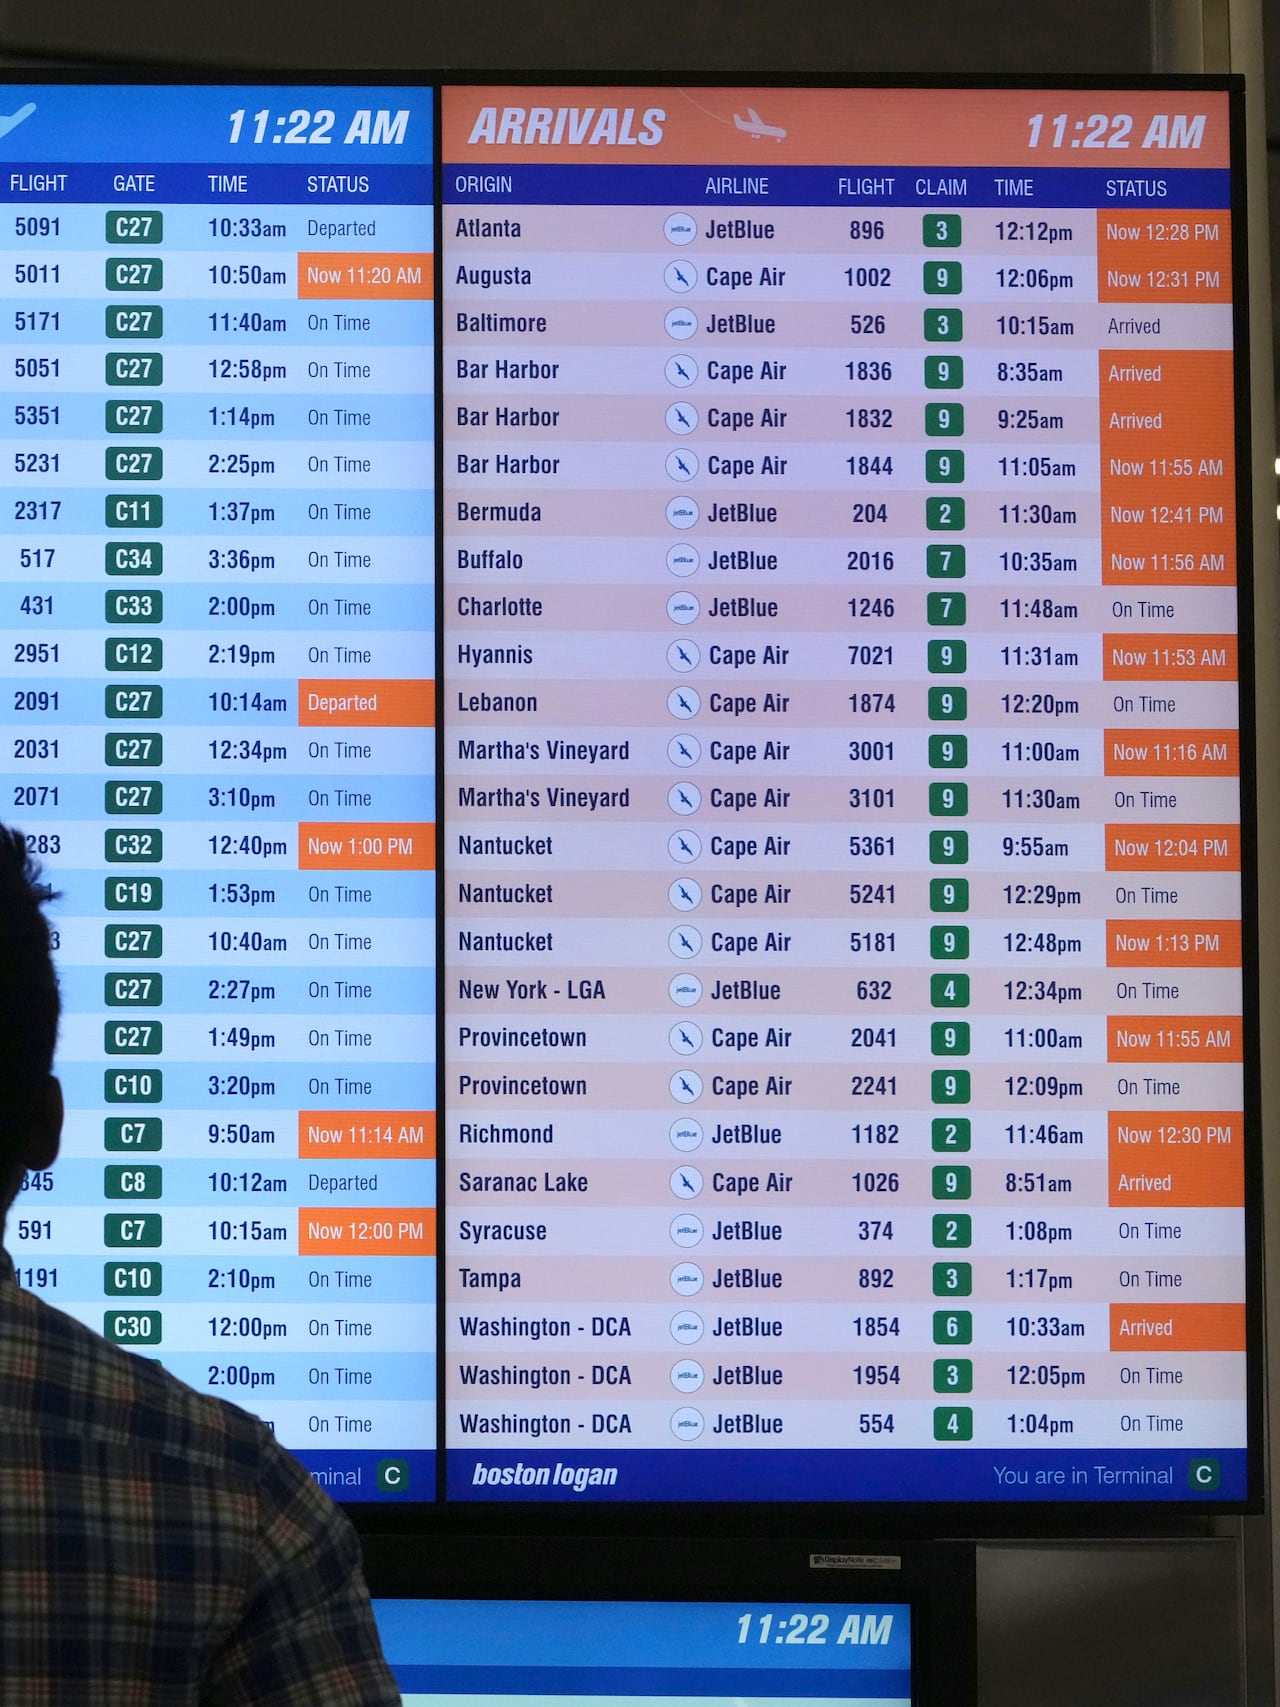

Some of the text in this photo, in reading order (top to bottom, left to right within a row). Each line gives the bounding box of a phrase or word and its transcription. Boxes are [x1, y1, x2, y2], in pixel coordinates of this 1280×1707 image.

[229, 109, 411, 145] 11:22 AM
[467, 107, 666, 146] ARRIVALS
[1026, 113, 1208, 149] 11:22 AM
[10, 174, 68, 192] FLIGHT
[113, 173, 155, 192] GATE
[207, 174, 248, 193] TIME
[307, 175, 370, 193] STATUS
[455, 175, 1168, 197] ORIGIN AIRLINE FLIGHT CLAIM TIME STATUS
[455, 218, 521, 238] Atlanta
[705, 219, 775, 239] JetBlue
[849, 220, 885, 240] 896
[936, 220, 948, 241] 3
[995, 221, 1073, 245] 12:12pm
[1106, 223, 1141, 241] Now
[1146, 223, 1190, 241] 12:28
[1194, 223, 1219, 241] PM
[15, 264, 59, 284] 5011
[115, 264, 153, 285] C27
[208, 265, 287, 285] 10:50am
[307, 266, 342, 284] Now
[347, 266, 392, 284] 11:20
[395, 267, 422, 284] AM
[19, 595, 53, 616] 431
[115, 595, 153, 616] C33
[208, 596, 275, 620] 2:00pm
[308, 598, 329, 616] On
[333, 599, 371, 616] Time
[13, 786, 58, 806] 2071
[115, 786, 152, 807] C27
[208, 787, 275, 811] 3:10pm
[308, 789, 329, 807] On
[334, 789, 372, 807] Time
[26, 835, 61, 854] 283
[115, 834, 152, 855] C32
[208, 835, 287, 859] 12:40pm
[308, 837, 343, 855] Now
[348, 837, 383, 855] 1:00
[387, 837, 413, 855] PM
[459, 1172, 1172, 1197] Saranac Lake Cape Air 1026 9 8:51am Arrived
[18, 1220, 51, 1240] 591
[120, 1219, 146, 1241] C7
[208, 1220, 287, 1241] 10:15am
[308, 1221, 344, 1240] Now
[349, 1222, 394, 1240] 12:00
[398, 1222, 424, 1240] PM
[459, 1413, 571, 1438] Washington
[592, 1413, 632, 1434] DCA
[712, 1413, 783, 1434] JetBlue
[859, 1413, 895, 1434] 554
[946, 1413, 959, 1434] 4
[1007, 1413, 1074, 1437] 1:04pm
[1120, 1415, 1141, 1432] On
[1146, 1414, 1183, 1432] Time
[311, 1466, 401, 1485] minal C
[993, 1465, 1212, 1485] You are in Terminal C
[738, 1614, 894, 1645] 11:22 AM
